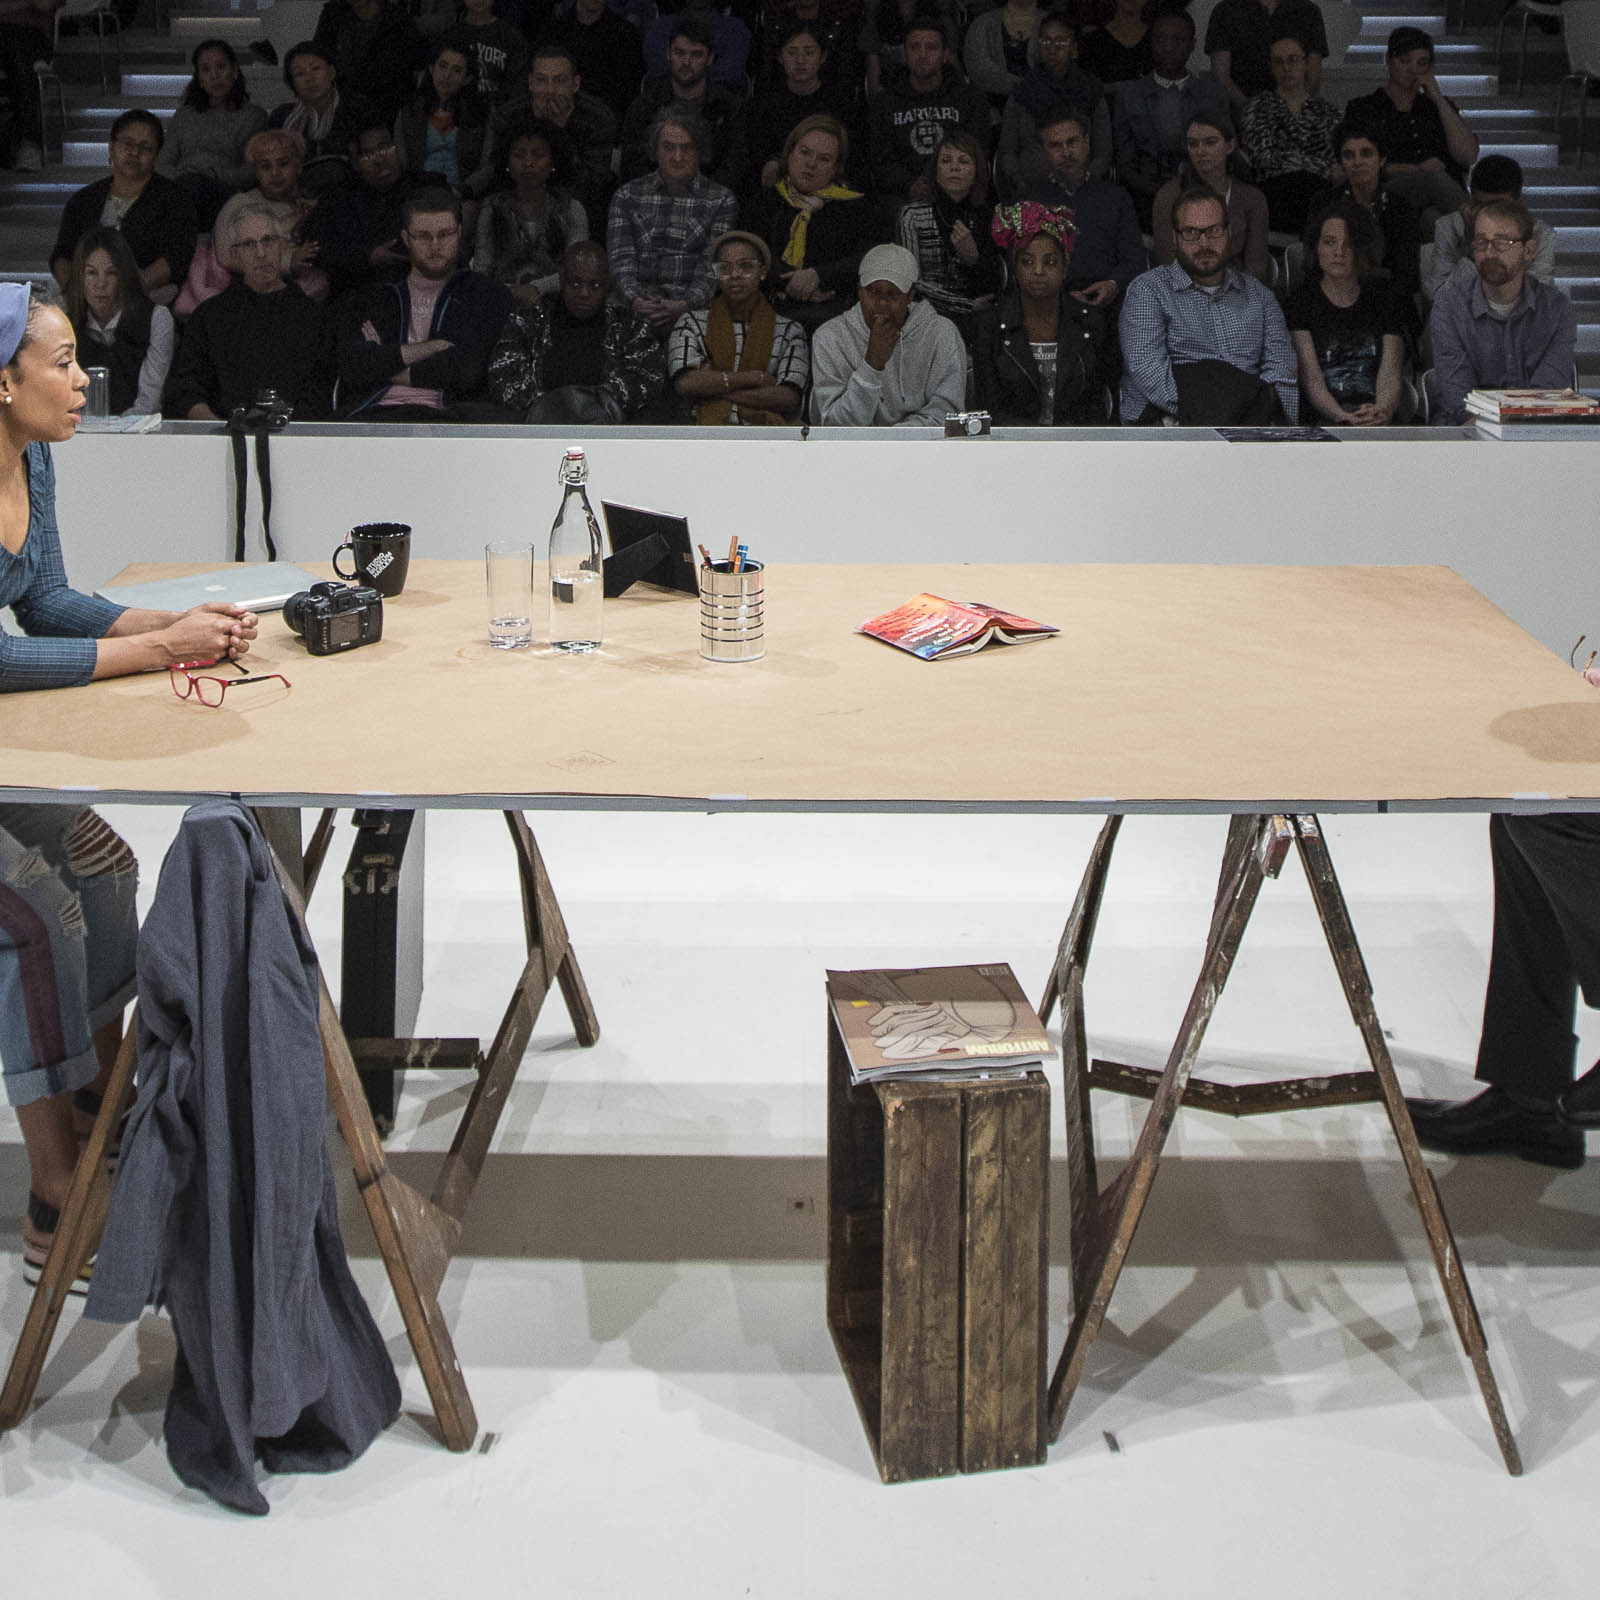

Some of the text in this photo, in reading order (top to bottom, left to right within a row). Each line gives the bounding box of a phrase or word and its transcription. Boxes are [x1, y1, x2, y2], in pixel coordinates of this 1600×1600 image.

[894, 106, 960, 126] HARVARD
[365, 552, 385, 571] STUDIO
[371, 556, 394, 579] HARLEM
[965, 1040, 1049, 1056] ARTFORUM
